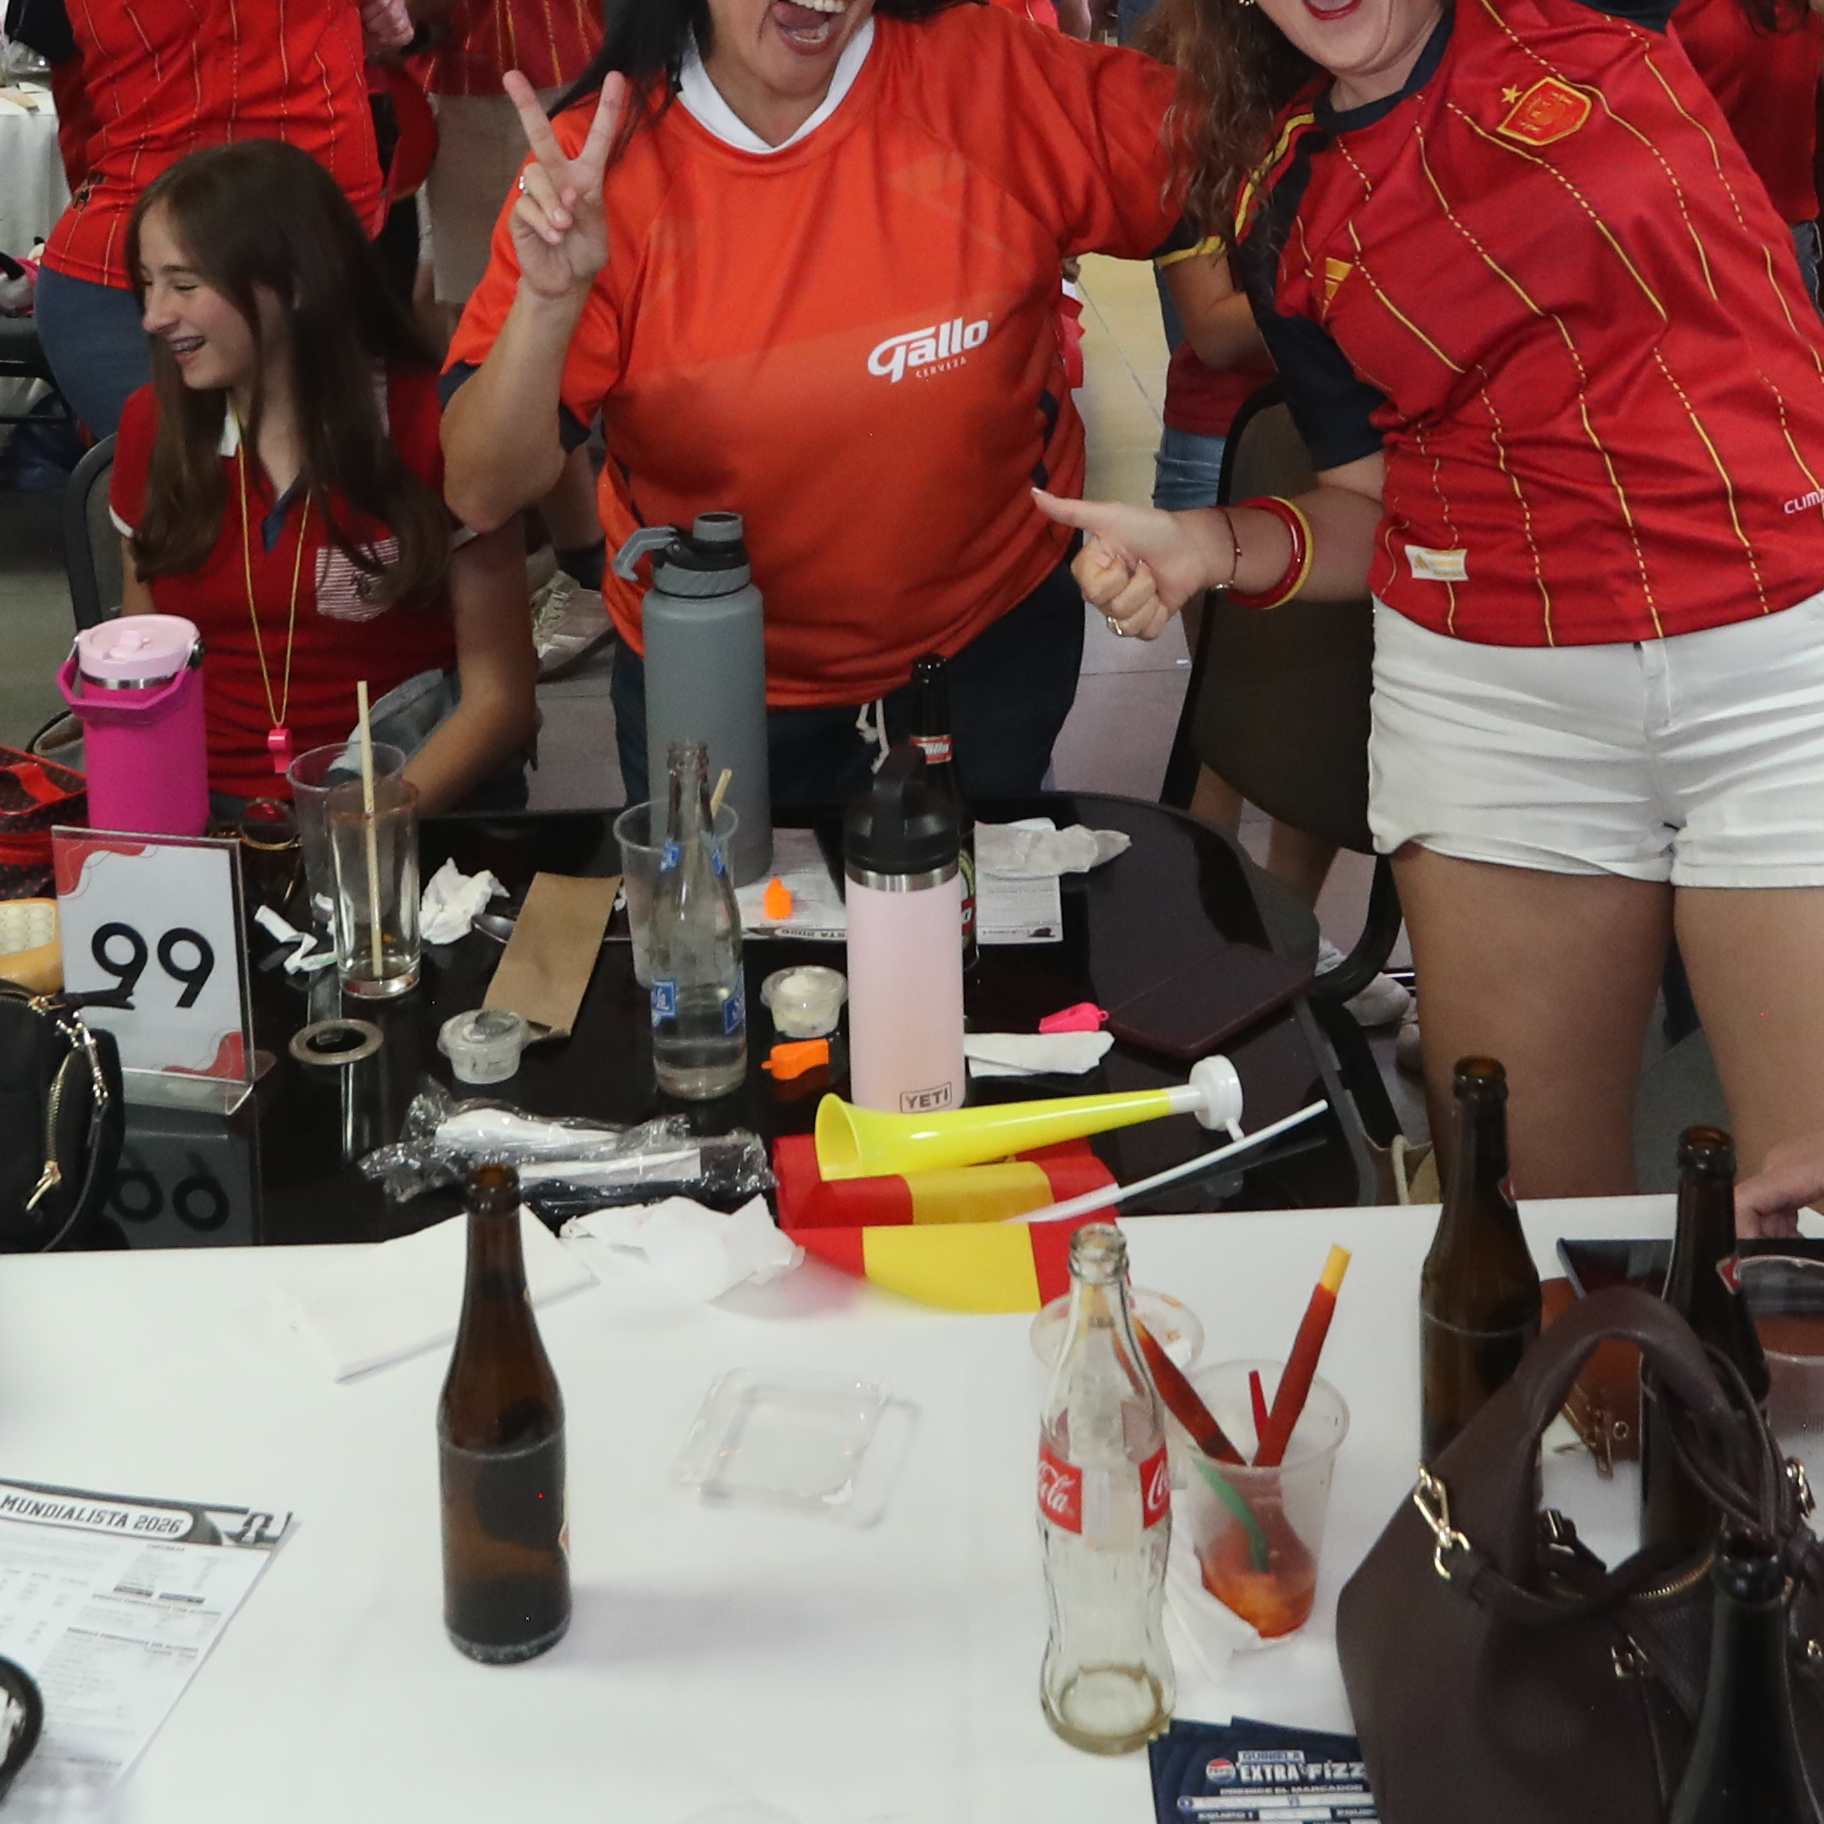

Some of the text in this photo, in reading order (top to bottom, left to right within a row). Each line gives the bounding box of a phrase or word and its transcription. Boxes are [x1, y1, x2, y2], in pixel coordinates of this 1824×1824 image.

[915, 356, 967, 378] CERVEZA
[91, 922, 215, 1008] 99
[905, 1087, 948, 1110] YETI
[0, 1494, 129, 1529] MUNDIALISTA
[133, 1515, 184, 1534] 2026
[1240, 1762, 1300, 1783] EXTRA
